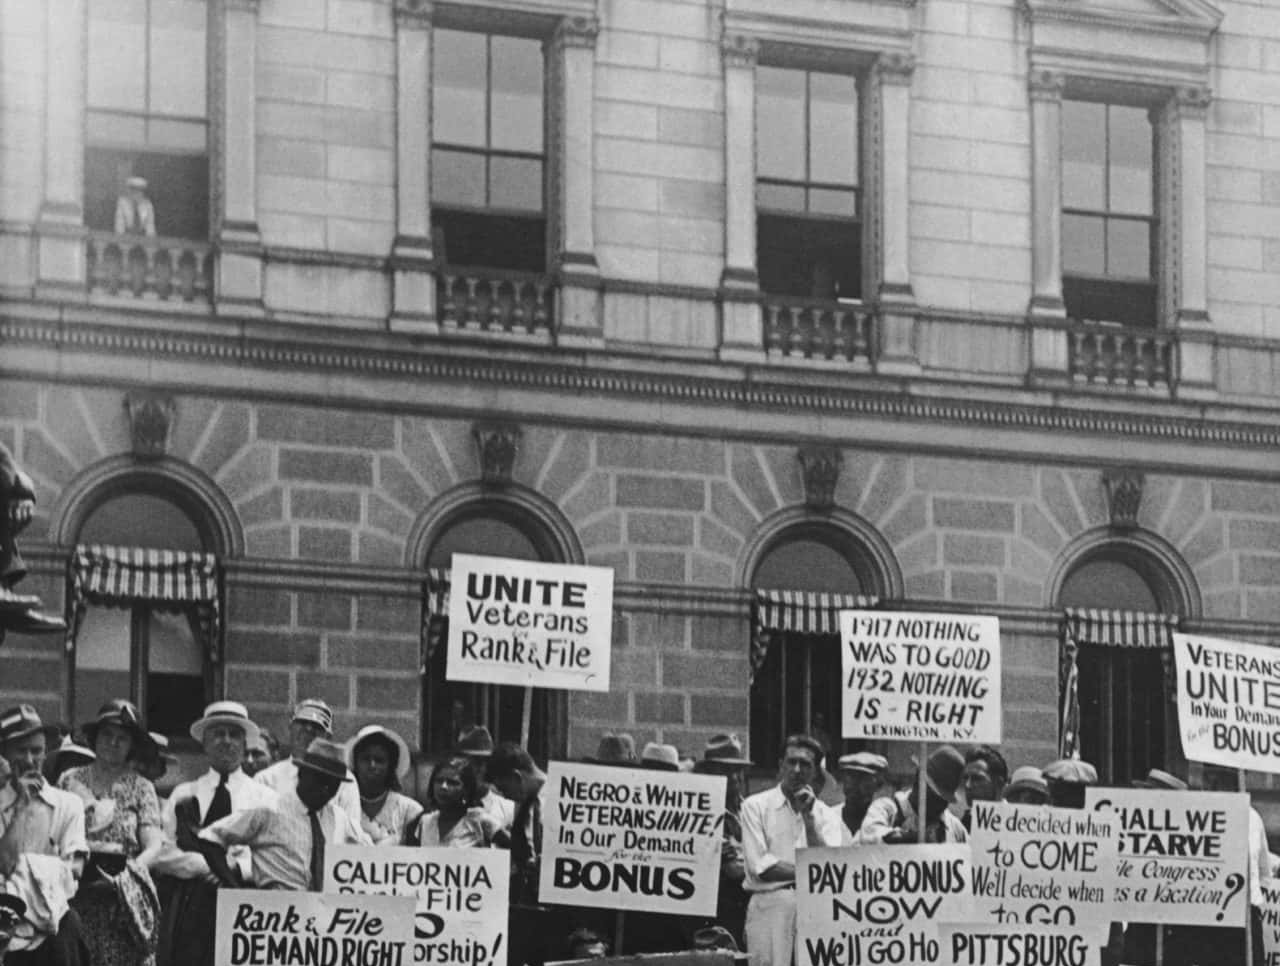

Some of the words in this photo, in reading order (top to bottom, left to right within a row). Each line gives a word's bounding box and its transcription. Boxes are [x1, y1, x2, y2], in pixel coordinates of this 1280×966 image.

[467, 573, 587, 608] UNITE
[467, 600, 588, 634] Veterans
[853, 617, 892, 638] 1917
[896, 619, 979, 642] NOTHING
[461, 629, 524, 663] Rank
[545, 638, 590, 668] File
[849, 641, 896, 665] WAS
[902, 643, 931, 666] TO
[935, 646, 990, 671] GOOD
[848, 667, 895, 692] 1932
[900, 671, 988, 700] NOTHING
[854, 694, 881, 719] IS
[906, 699, 983, 727] RIGHT
[560, 776, 630, 804] NEGRO
[646, 783, 711, 811] WHITE
[559, 802, 657, 831] VETERANS
[976, 805, 1001, 832] We
[1006, 808, 1071, 835] decided
[1076, 814, 1111, 838] when
[1186, 810, 1227, 833] WE
[559, 825, 574, 844] In
[580, 828, 616, 848] Our
[624, 830, 695, 855] Demand
[986, 840, 1014, 868] to
[1021, 840, 1098, 872] COME
[1142, 860, 1220, 882] Congress
[333, 860, 492, 889] CALIFORNIA
[554, 857, 695, 900] BONUS
[808, 861, 847, 894] PAY
[853, 865, 885, 893] the
[889, 859, 965, 893] BONUS
[1010, 874, 1062, 901] decide
[1068, 880, 1104, 903] when
[427, 888, 482, 912] File
[832, 896, 943, 924] NOW
[233, 904, 300, 933] Rank
[327, 907, 384, 936] File
[868, 940, 905, 964] GO
